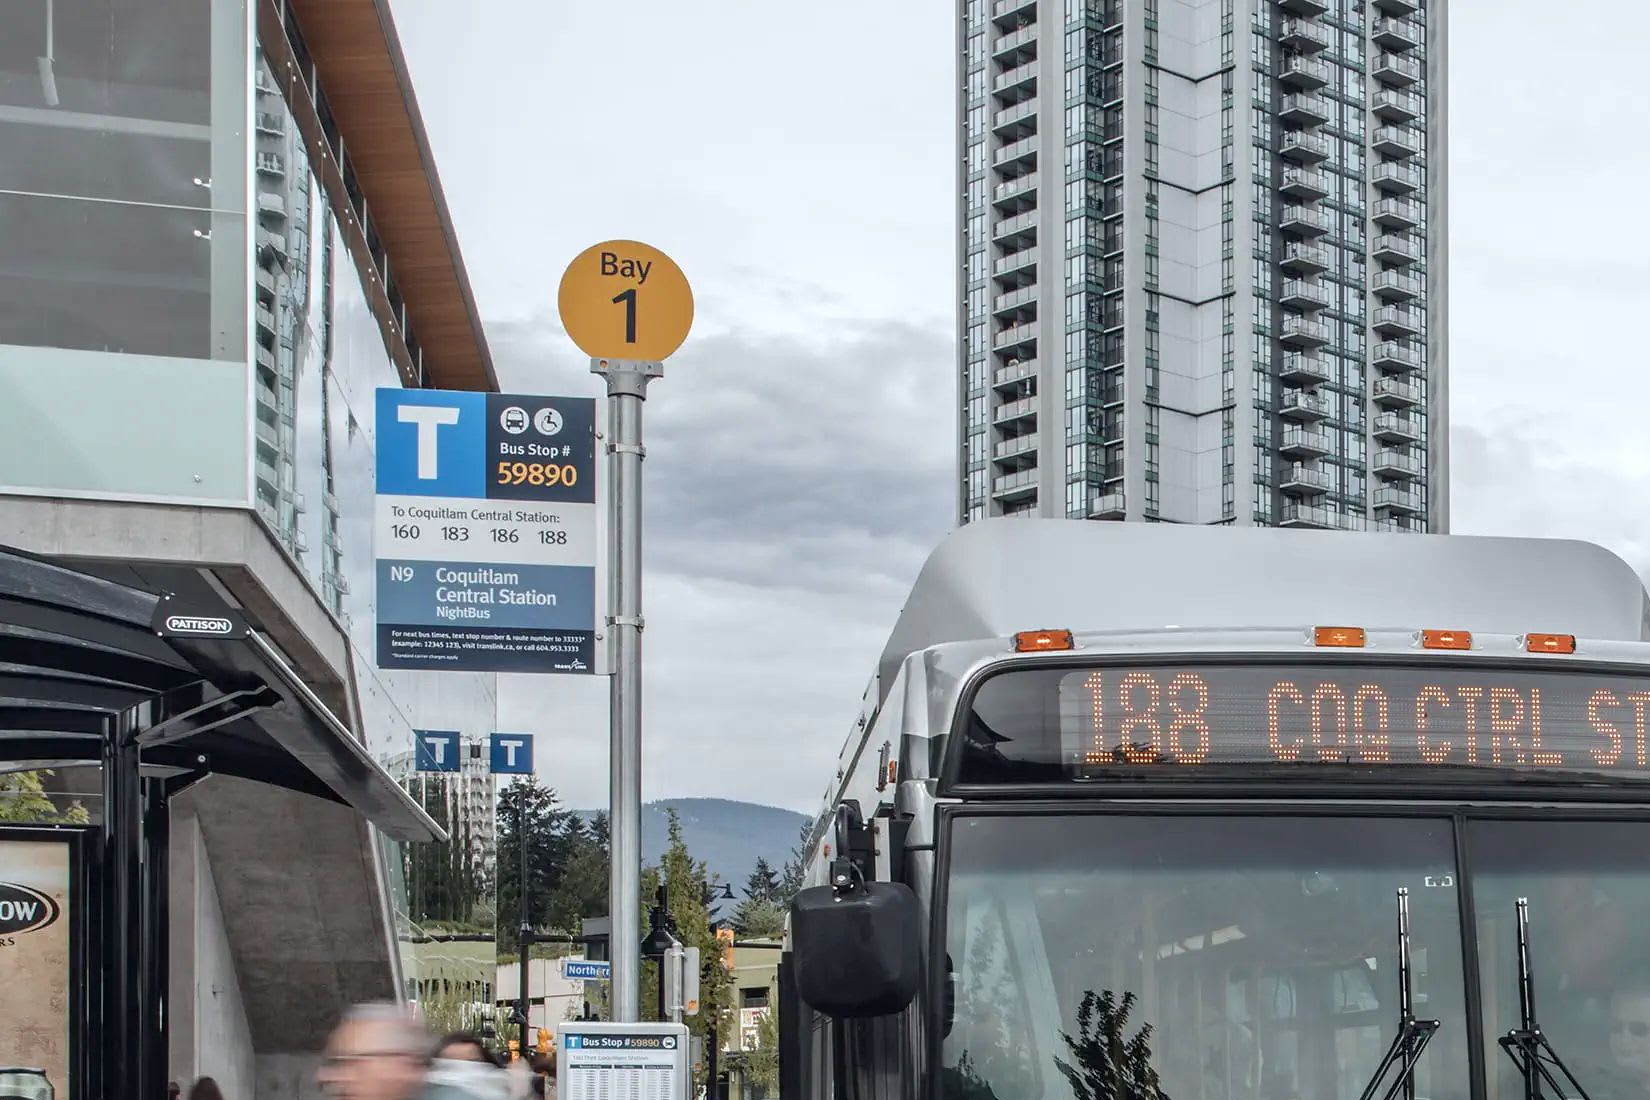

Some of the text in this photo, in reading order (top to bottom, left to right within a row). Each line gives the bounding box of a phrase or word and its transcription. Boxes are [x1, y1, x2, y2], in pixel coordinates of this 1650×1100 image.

[600, 252, 652, 285] Bay
[612, 288, 637, 343] 1
[398, 405, 460, 480] T
[500, 442, 570, 458] Bus Stop #
[498, 461, 578, 487] 59890
[391, 506, 560, 523] To Coquitlam Central Station:
[391, 524, 567, 545] 160 183 186 188
[391, 566, 519, 587] N9 Coquitlam
[436, 587, 556, 606] Central Station
[436, 606, 490, 620] NightBus
[172, 620, 227, 630] PATTISON
[480, 633, 505, 641] number
[1083, 671, 1209, 767] 188
[1267, 680, 1389, 763] COQ
[1416, 686, 1563, 765] CTRL
[500, 740, 523, 767] T
[583, 1038, 599, 1047] Bus
[601, 1038, 623, 1048] Stop
[631, 1038, 660, 1047] 59890
